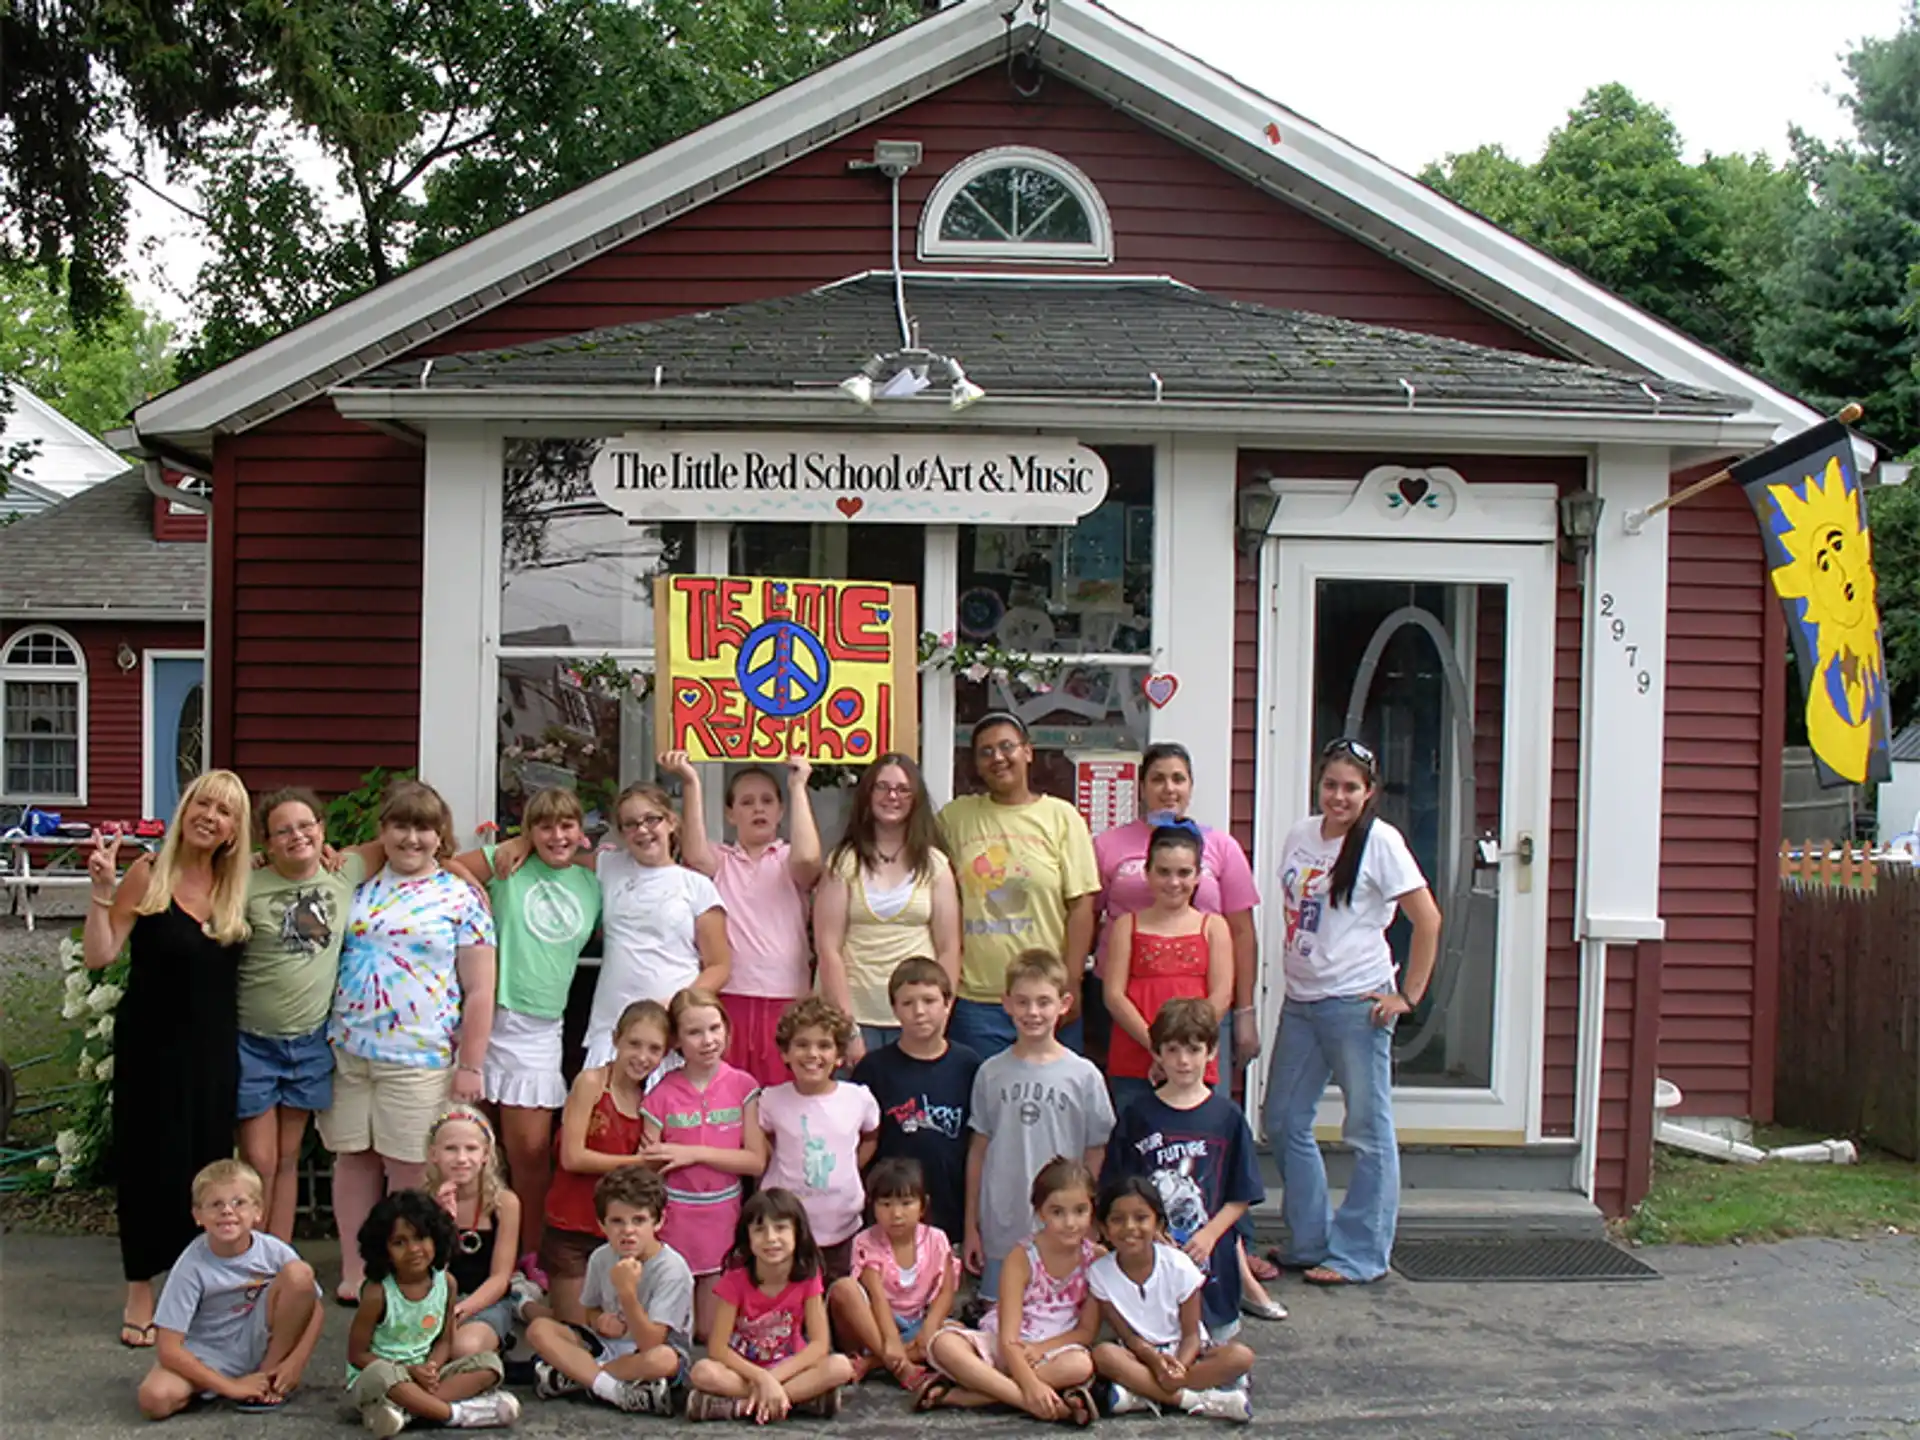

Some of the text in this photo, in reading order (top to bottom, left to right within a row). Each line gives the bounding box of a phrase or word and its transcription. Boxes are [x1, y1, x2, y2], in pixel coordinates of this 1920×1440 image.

[610, 451, 1094, 495] The Little Red School of Art & Music
[1600, 592, 1651, 695] 2979
